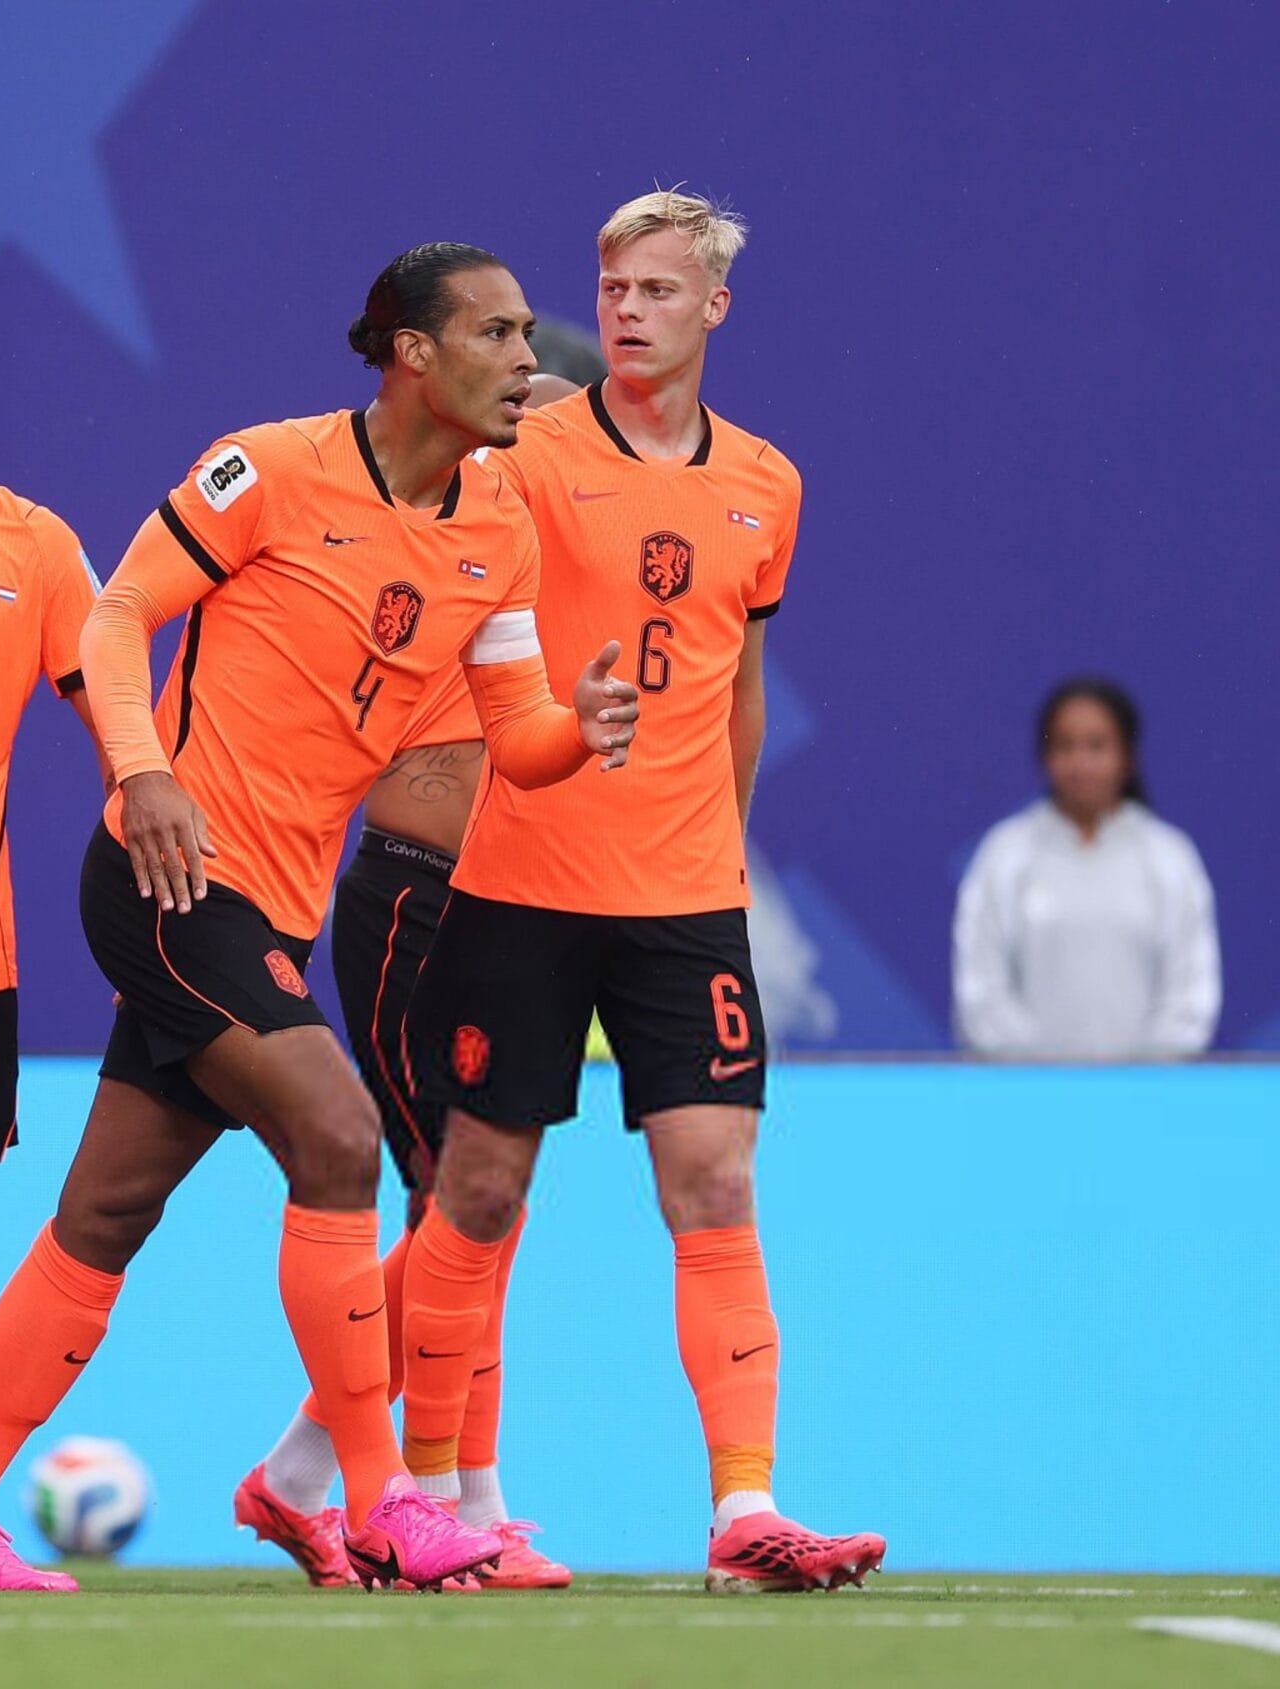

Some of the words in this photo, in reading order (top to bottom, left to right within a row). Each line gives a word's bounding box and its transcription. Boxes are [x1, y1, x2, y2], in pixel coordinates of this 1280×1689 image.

[351, 654, 385, 732] 4
[636, 616, 674, 695] 6
[384, 839, 423, 860] Calvin
[423, 850, 455, 873] Klein
[710, 973, 751, 1051] 6
